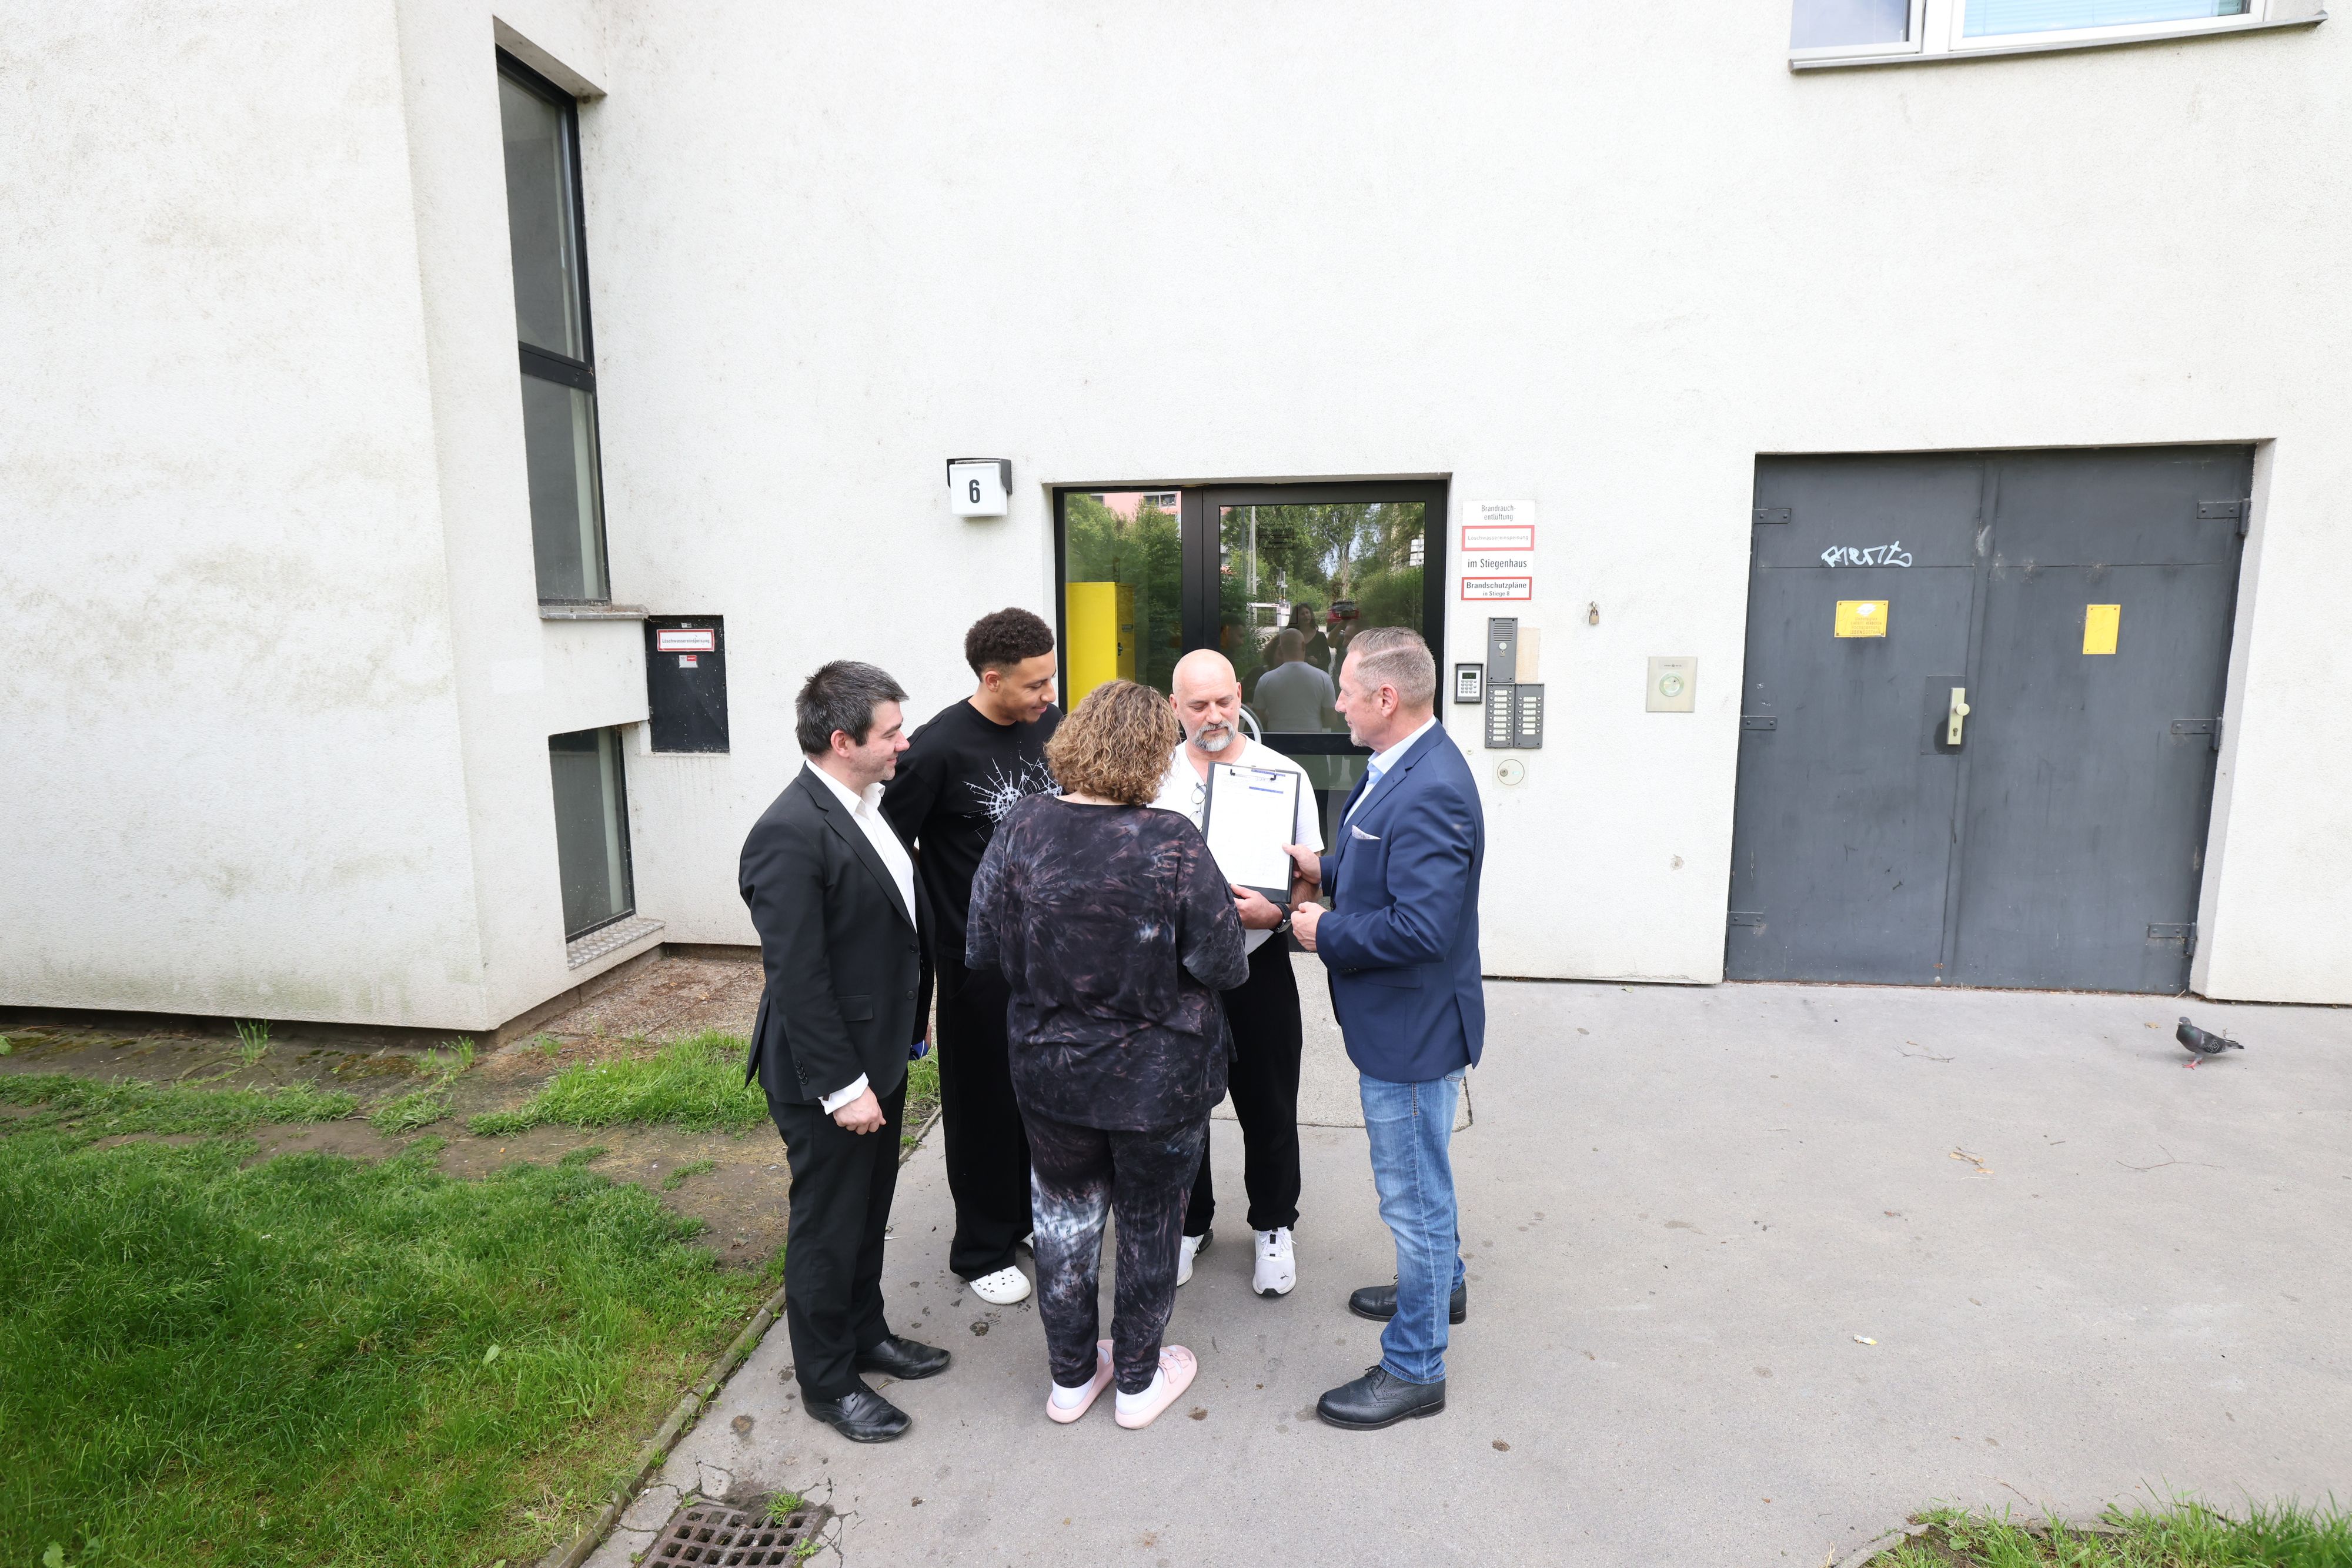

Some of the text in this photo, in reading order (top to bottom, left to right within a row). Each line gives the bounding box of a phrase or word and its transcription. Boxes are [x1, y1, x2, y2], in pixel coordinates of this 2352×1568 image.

[969, 479, 980, 503] 6
[1484, 513, 1513, 521] entlüftung
[1468, 559, 1527, 570] im Stiegenhaus
[1466, 581, 1527, 590] Brandschutzpläne
